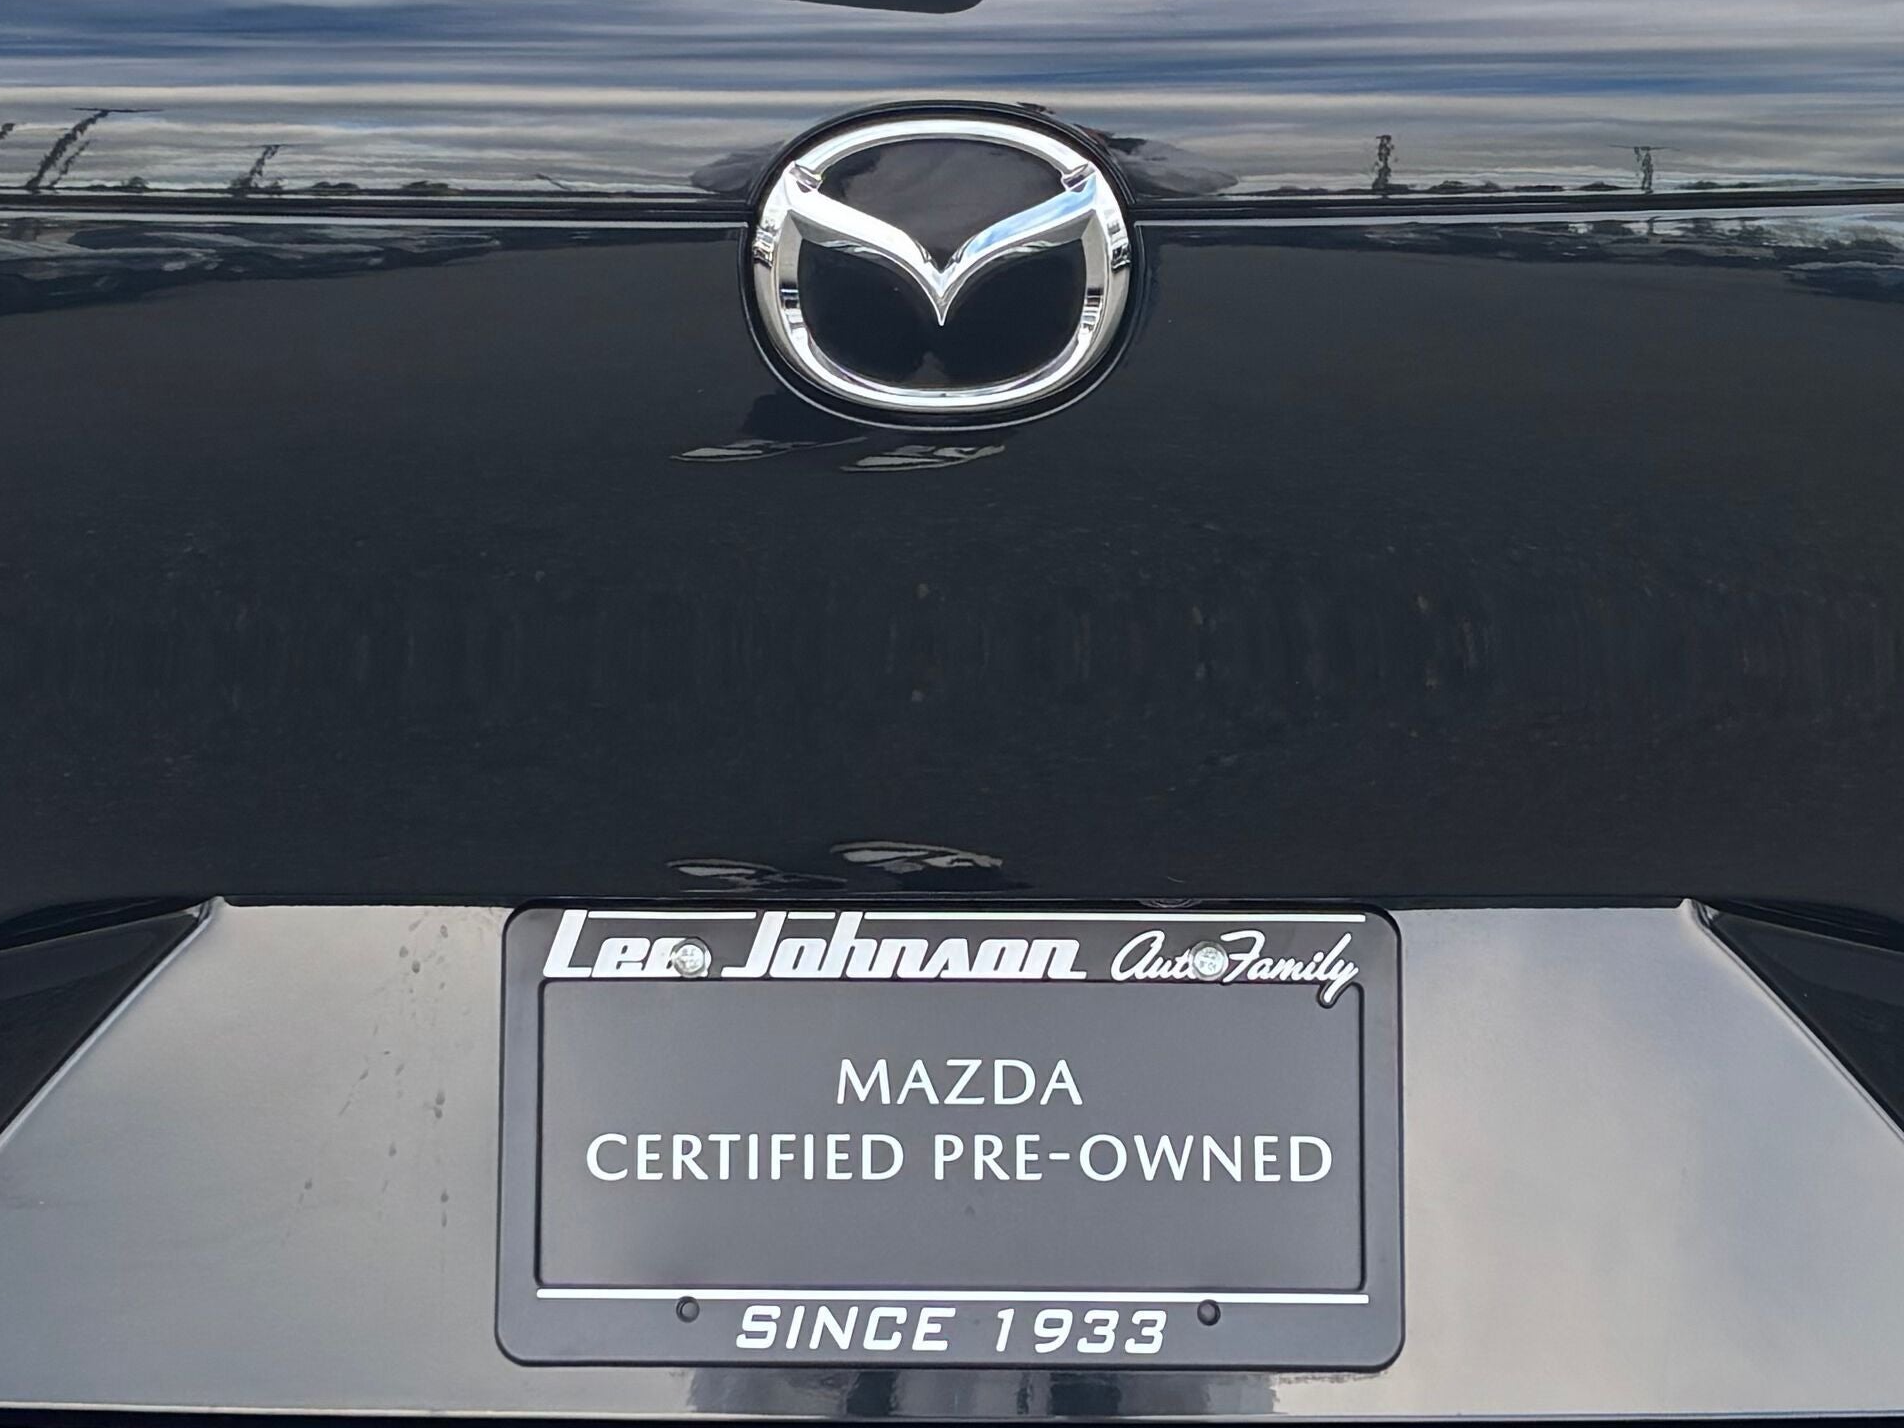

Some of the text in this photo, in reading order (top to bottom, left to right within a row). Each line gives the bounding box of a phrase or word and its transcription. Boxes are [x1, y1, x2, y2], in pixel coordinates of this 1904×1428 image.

[721, 911, 1087, 980] Johnson
[1111, 929, 1216, 982] Aut
[1220, 929, 1360, 1003] Family
[836, 1059, 1084, 1107] MAZDA
[585, 1133, 1334, 1183] CERTIFIED PRE-OWNED
[736, 1305, 1168, 1355] SINCE 1933
